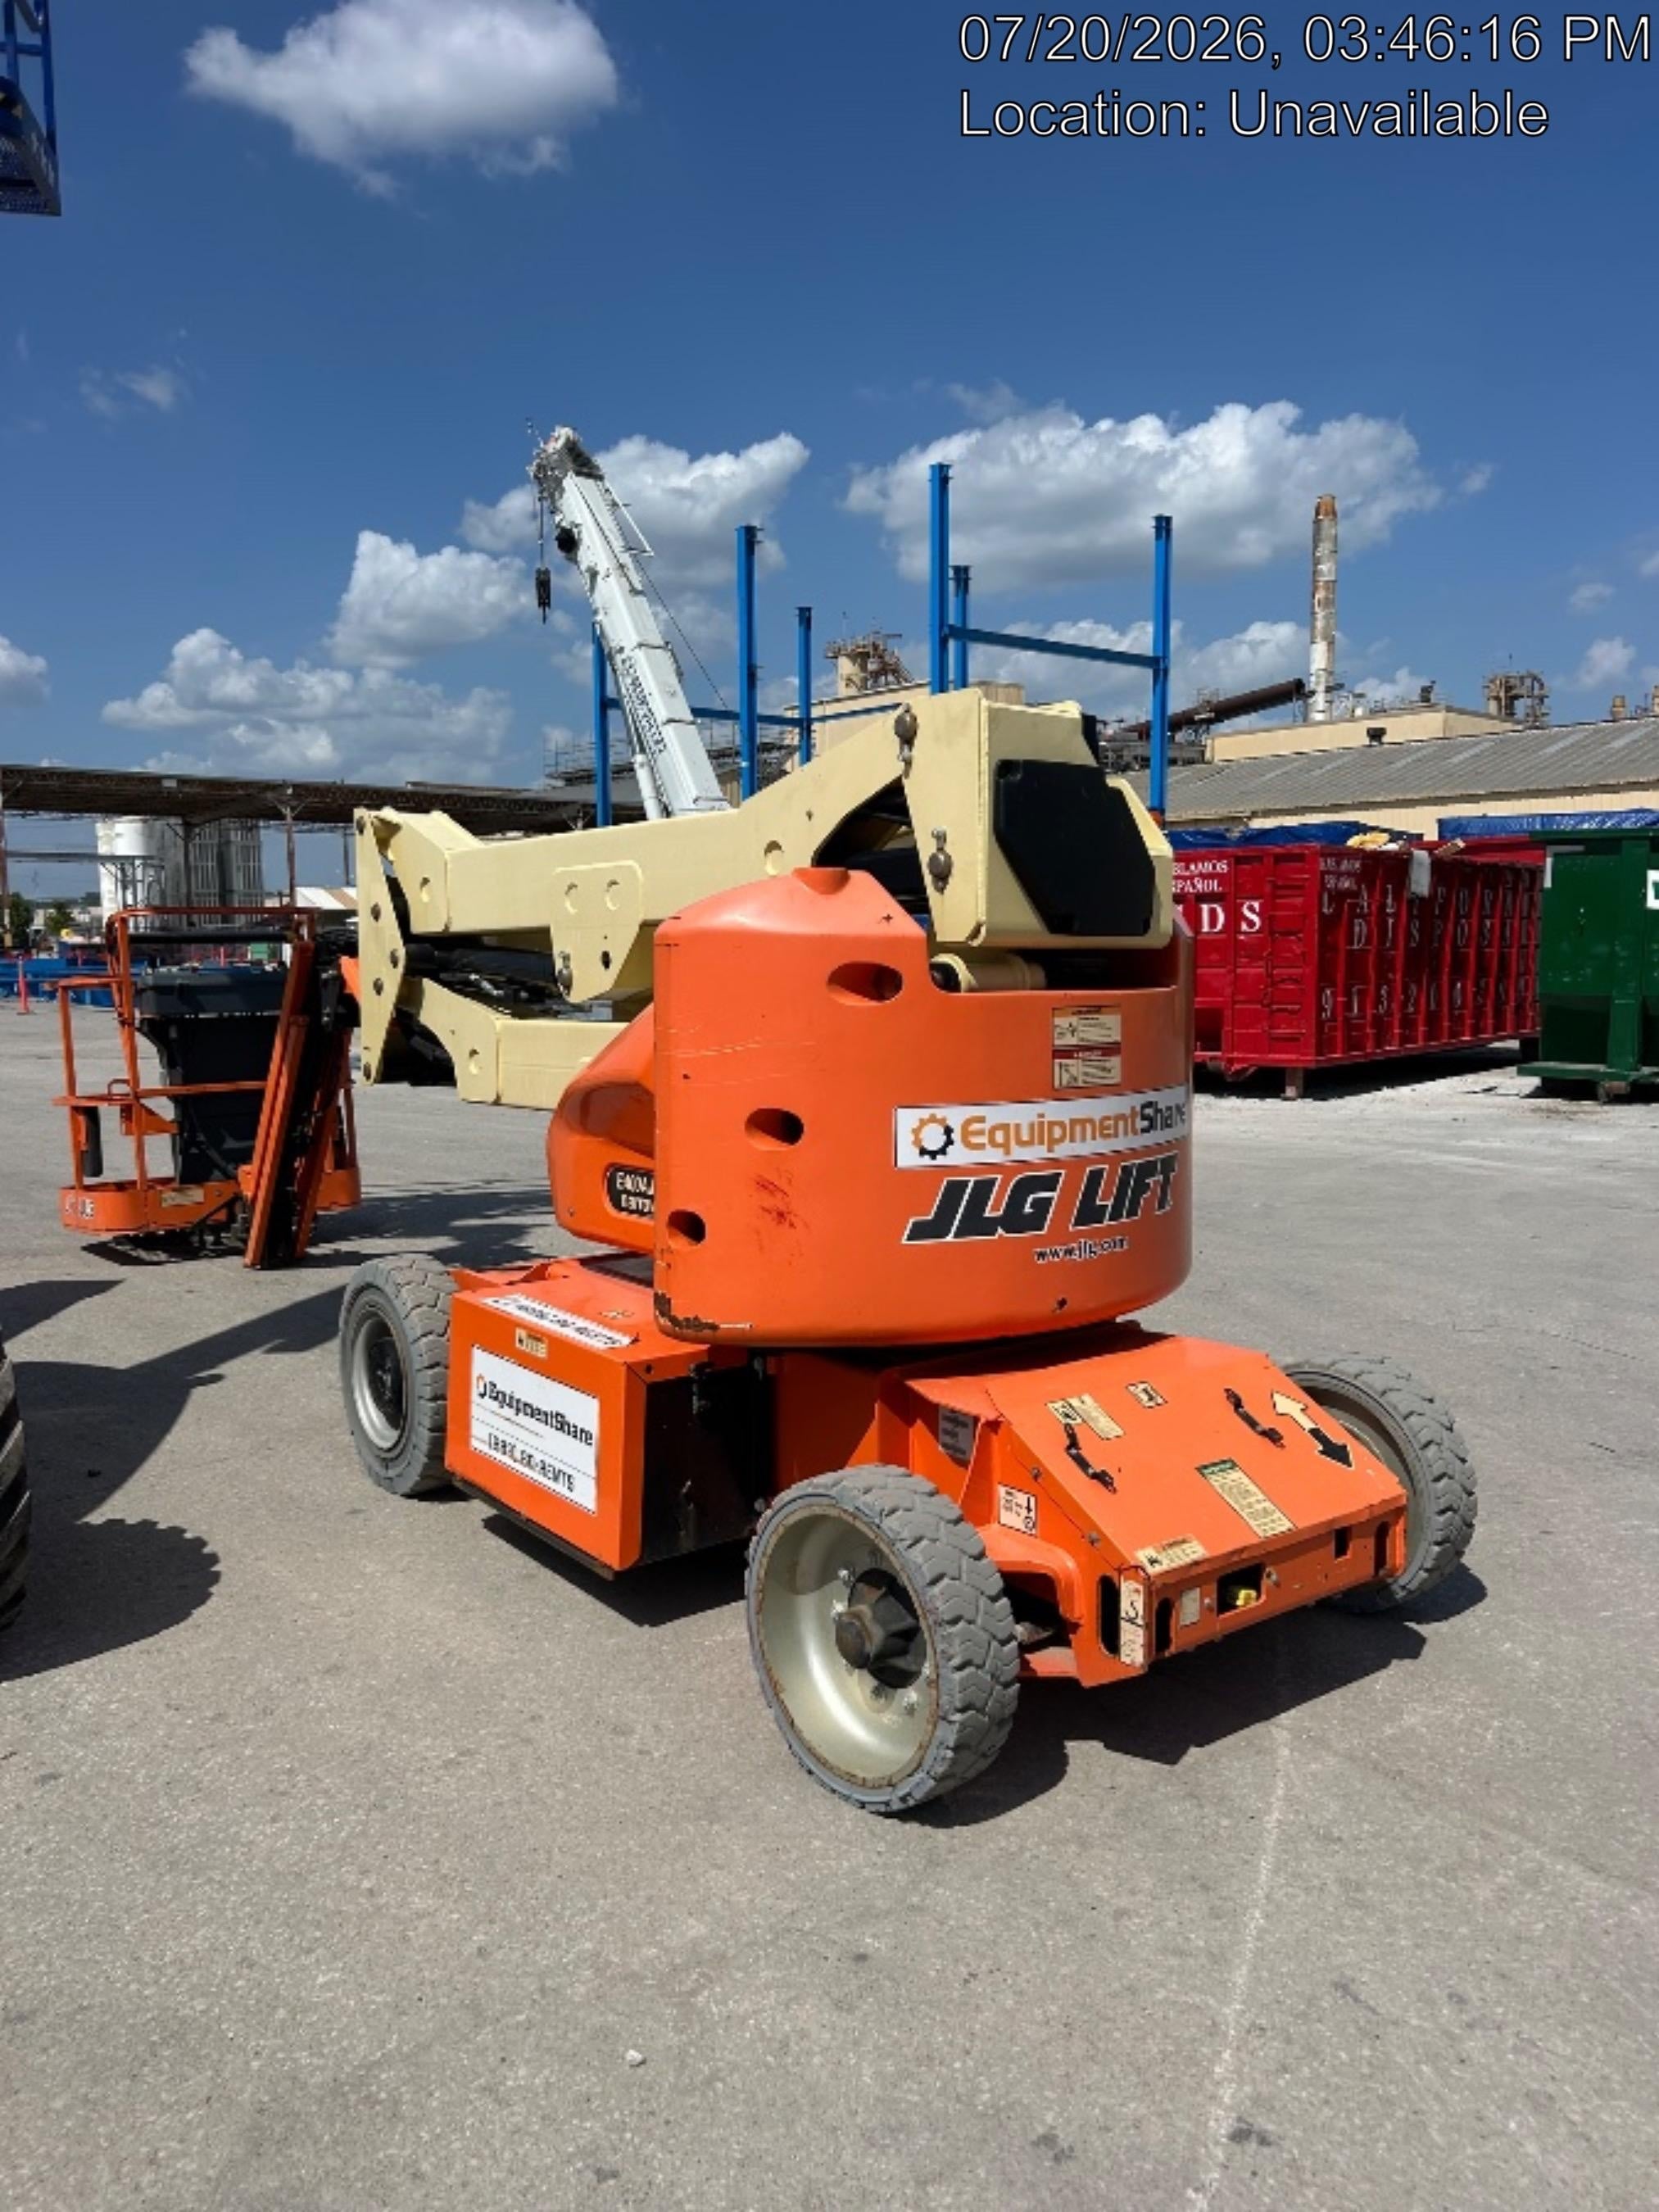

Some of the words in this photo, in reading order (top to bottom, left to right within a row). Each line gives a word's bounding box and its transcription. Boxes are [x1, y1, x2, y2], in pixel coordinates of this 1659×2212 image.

[960, 1100, 1186, 1156] EquipmentShare
[902, 1170, 1066, 1244] JLG
[1070, 1152, 1178, 1231] LIFT
[488, 1380, 593, 1446] EquipmentShare
